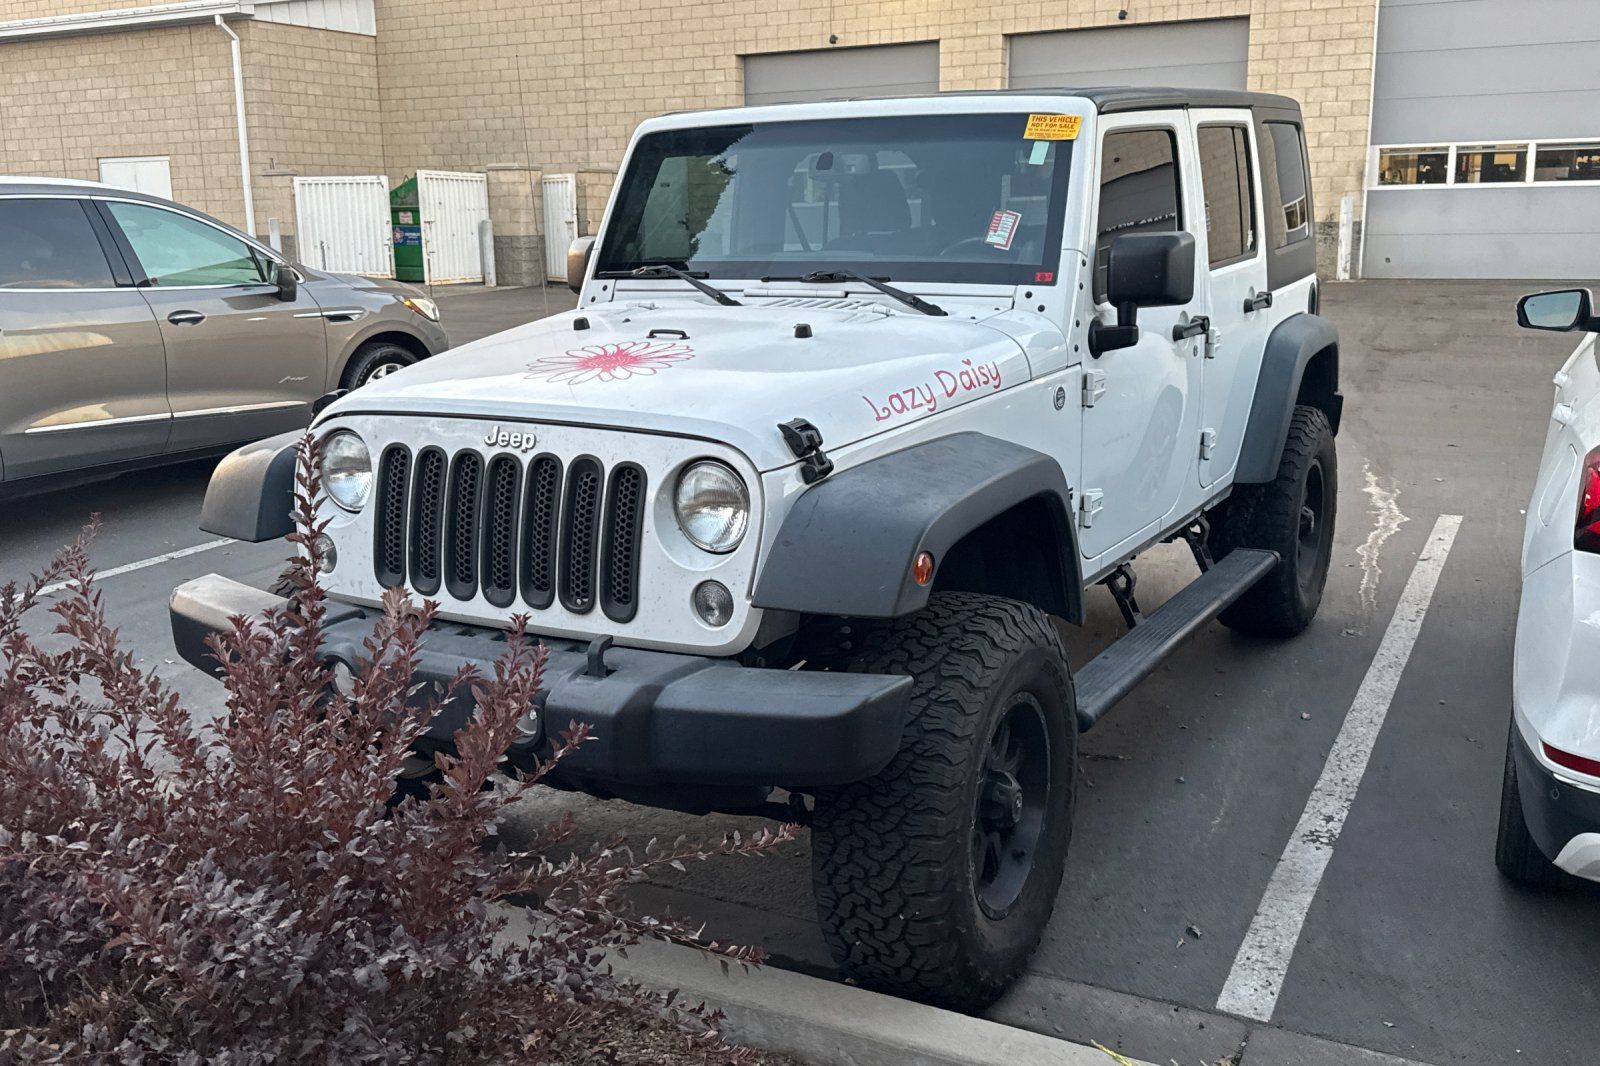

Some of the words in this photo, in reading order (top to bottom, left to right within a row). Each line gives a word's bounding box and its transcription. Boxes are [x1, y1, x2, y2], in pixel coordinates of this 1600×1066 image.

[1031, 115, 1048, 123] THIS
[1049, 116, 1079, 124] VEHICLE
[862, 383, 937, 421] Lazy
[934, 358, 1002, 398] Daisy
[484, 425, 537, 453] Jeep
